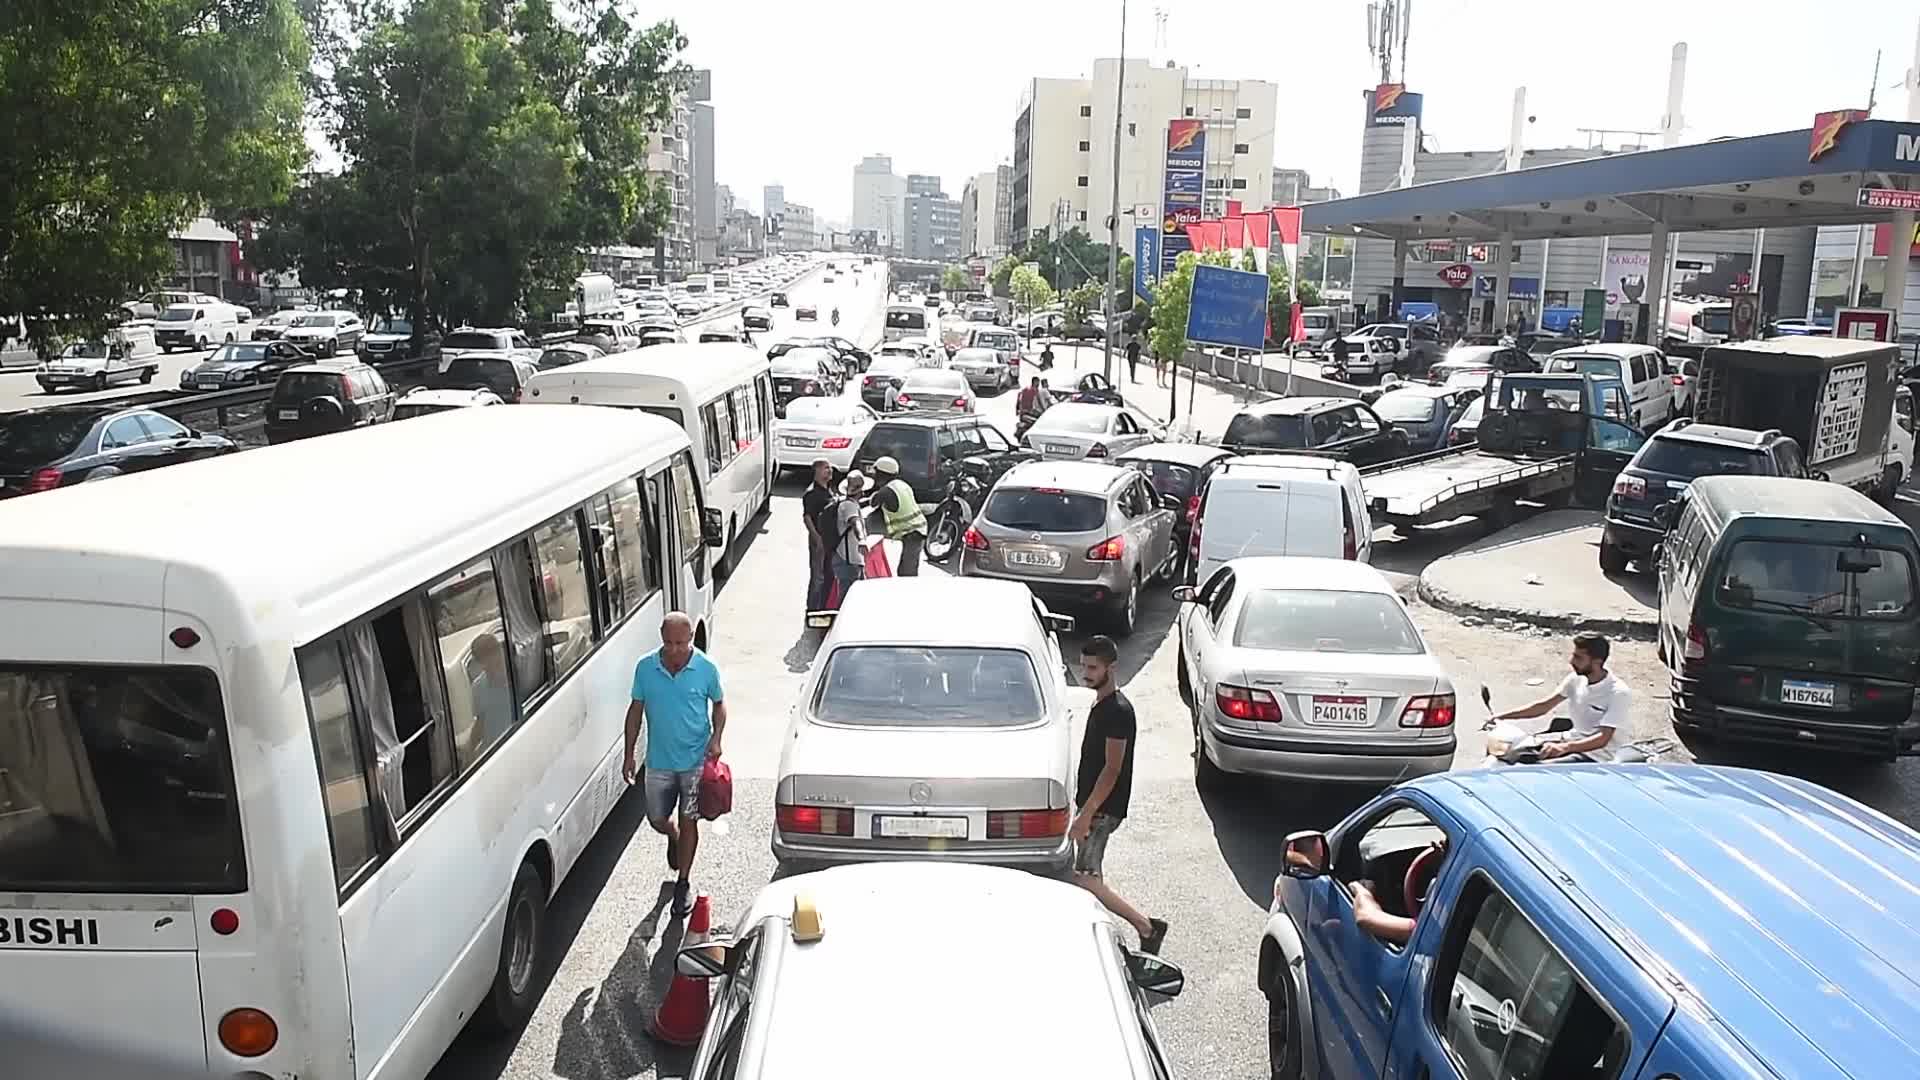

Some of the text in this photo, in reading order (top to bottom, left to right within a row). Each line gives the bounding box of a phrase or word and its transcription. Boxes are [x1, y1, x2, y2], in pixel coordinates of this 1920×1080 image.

[1168, 159, 1201, 167] MEDCO
[1174, 211, 1198, 225] Yala
[1445, 269, 1468, 280] Yala
[1783, 689, 1832, 704] M167644
[1314, 706, 1367, 721] P401416
